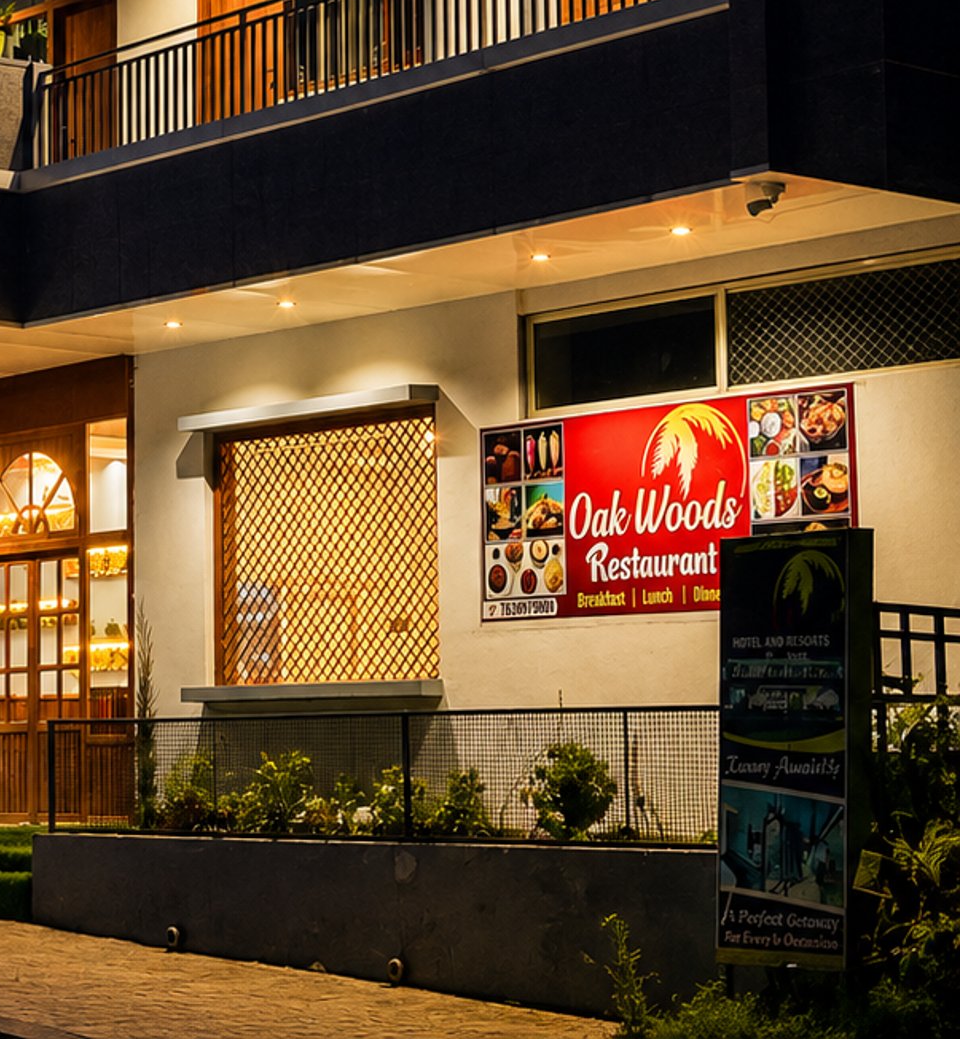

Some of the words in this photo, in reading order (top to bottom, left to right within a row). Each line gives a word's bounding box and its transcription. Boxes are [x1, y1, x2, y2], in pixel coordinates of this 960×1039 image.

[568, 489, 632, 540] Oak
[635, 480, 742, 535] Woods
[586, 542, 718, 583] Restaurant
[577, 590, 626, 608] Breakfast
[642, 587, 674, 605] Lunch
[693, 585, 721, 602] Dinne
[731, 636, 762, 649] HOTEL
[764, 635, 784, 648] AND
[785, 634, 831, 648] RESORTS
